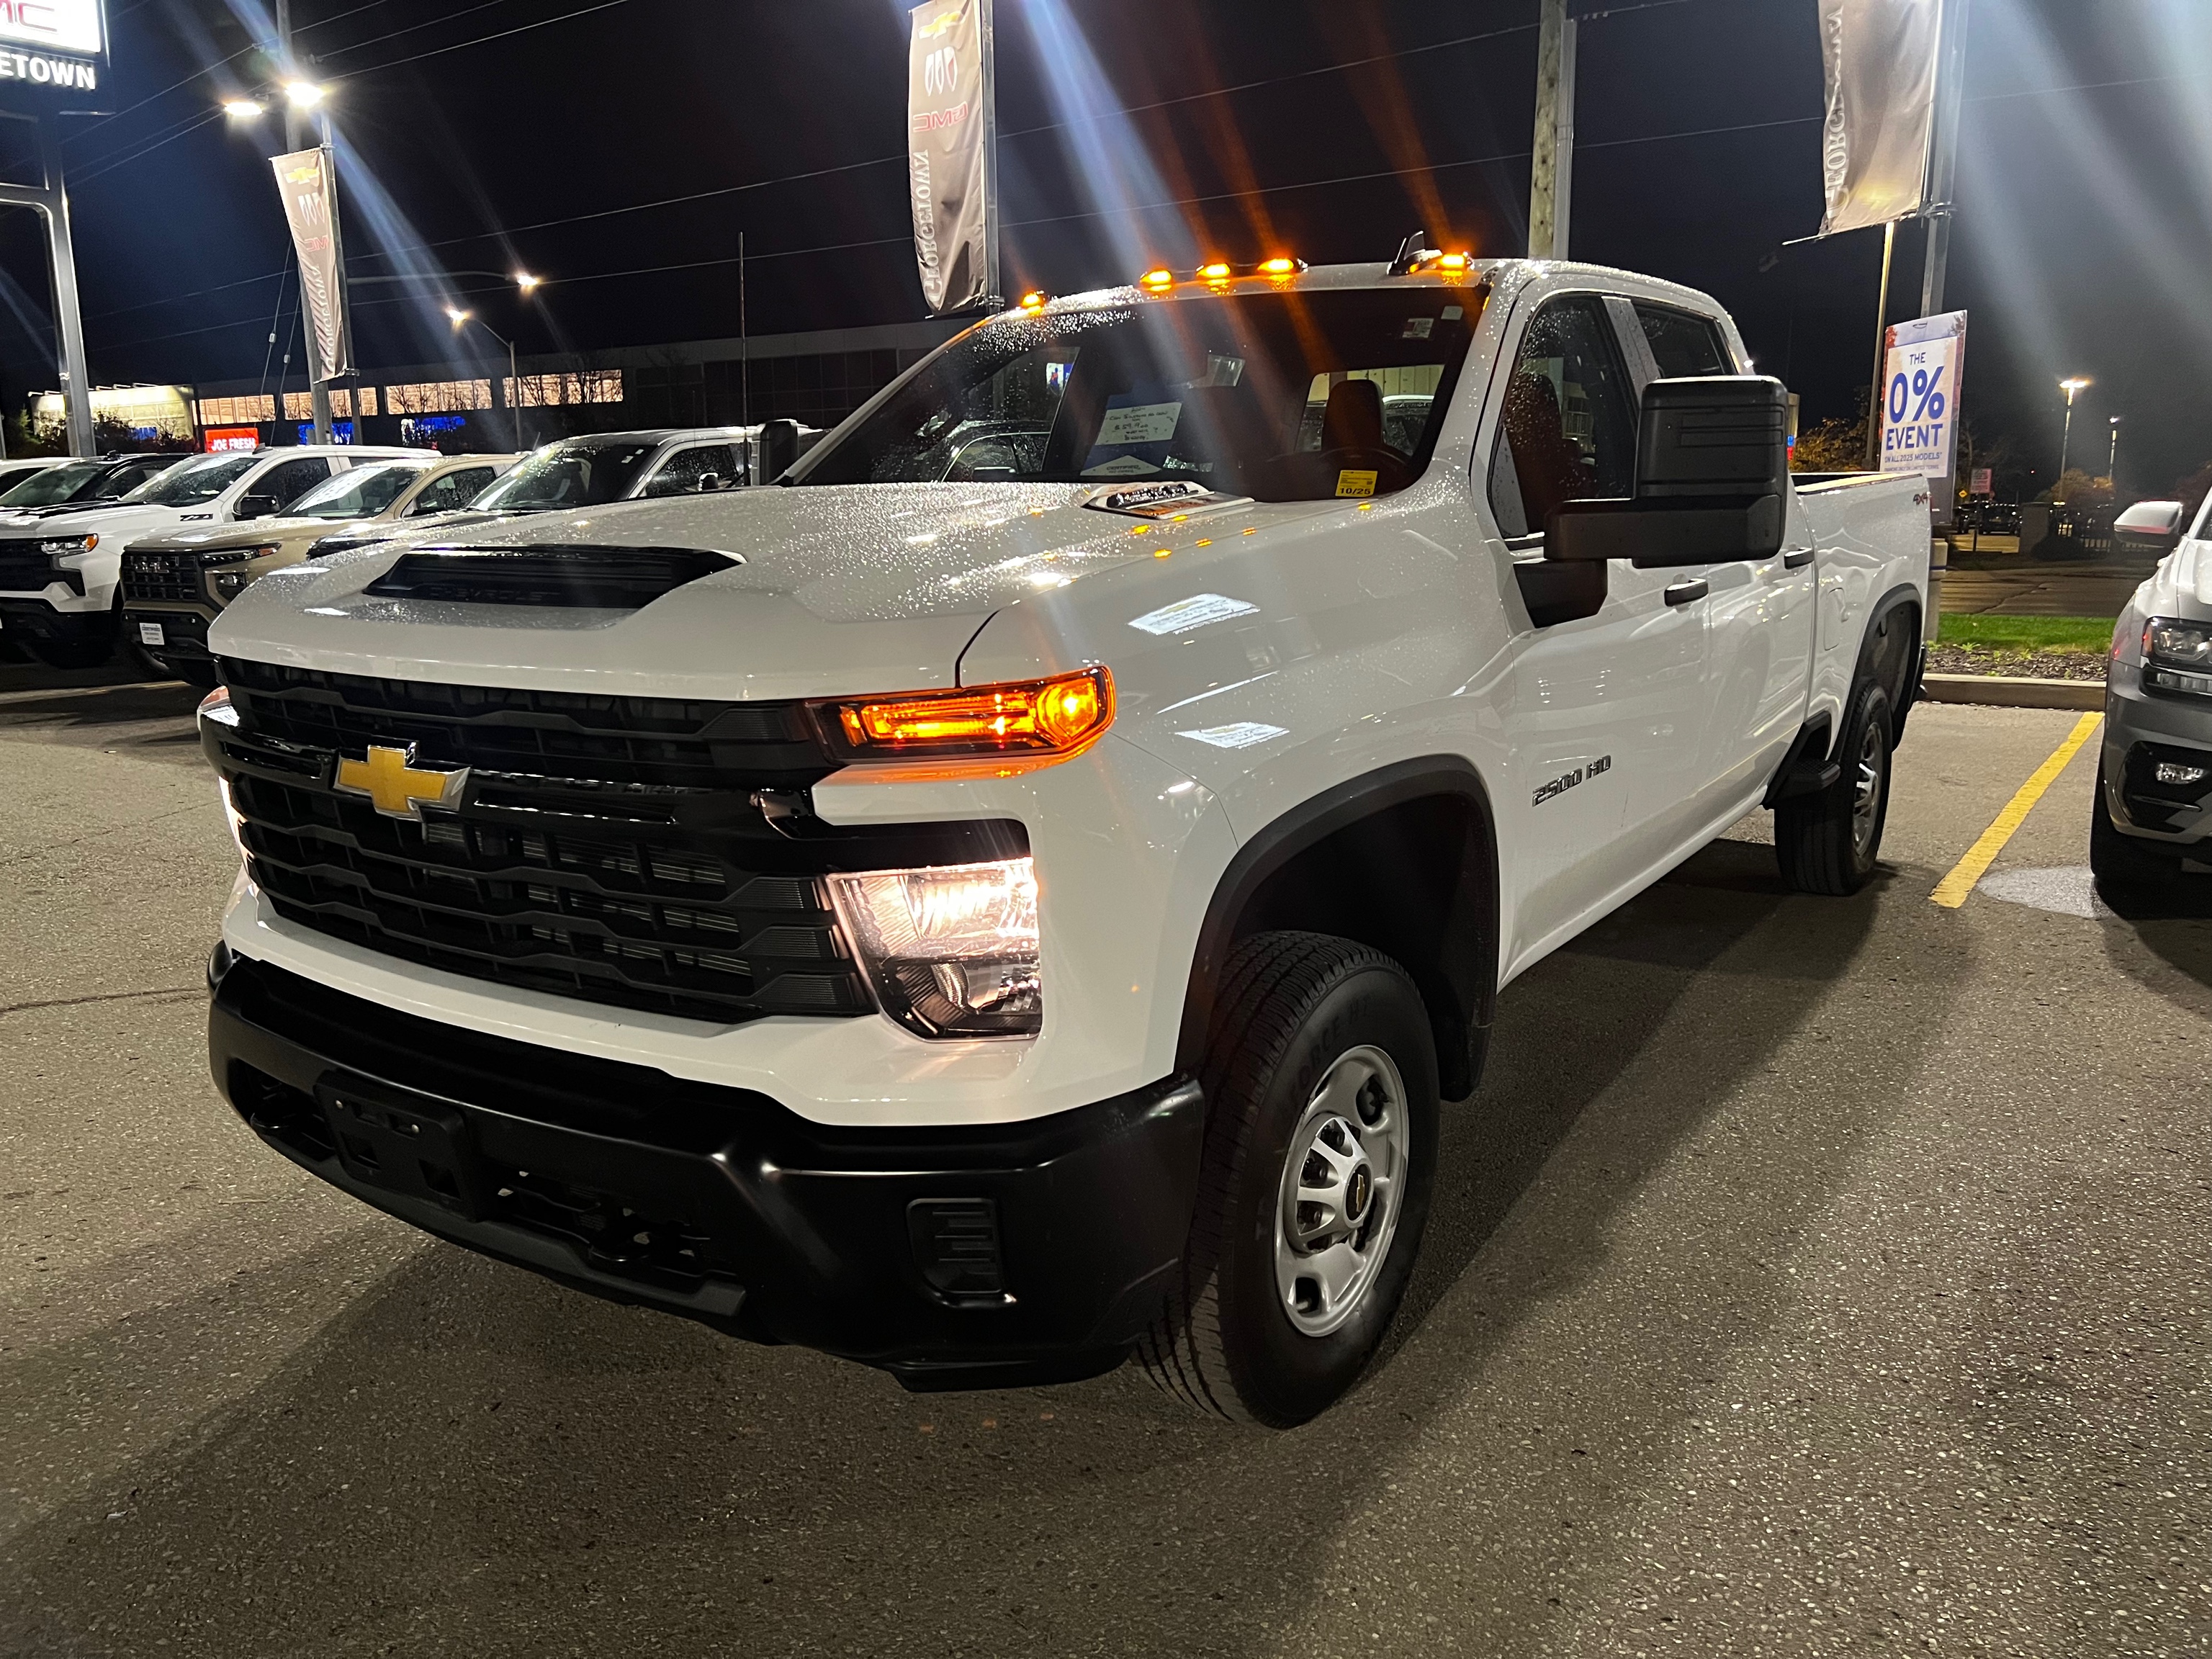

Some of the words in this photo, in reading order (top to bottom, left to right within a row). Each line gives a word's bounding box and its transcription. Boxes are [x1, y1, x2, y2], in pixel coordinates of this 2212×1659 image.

[1910, 352, 1926, 365] THE
[1889, 365, 1945, 423] 0%
[211, 439, 228, 451] JOE
[228, 437, 257, 450] FRESH
[1886, 423, 1943, 451] EVENT
[1532, 768, 1583, 807] 2500
[1586, 755, 1611, 780] HD
